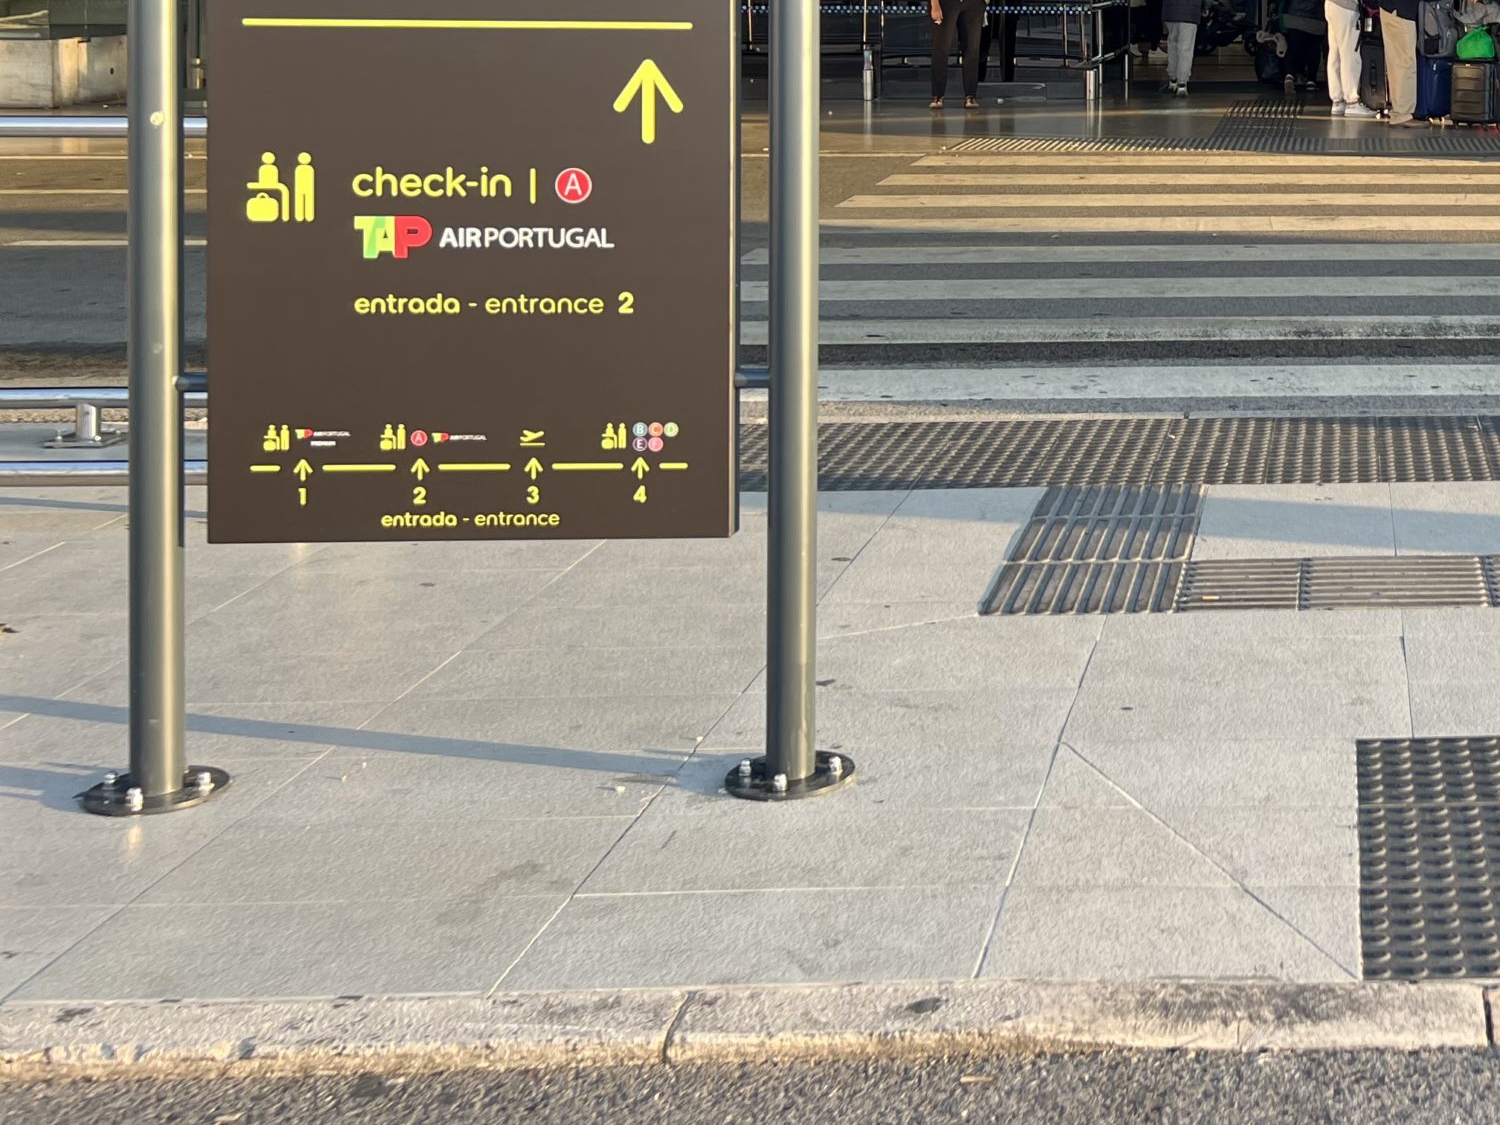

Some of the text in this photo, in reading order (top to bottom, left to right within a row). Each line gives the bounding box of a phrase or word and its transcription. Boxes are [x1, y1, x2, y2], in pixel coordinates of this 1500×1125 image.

[351, 167, 513, 198] check-in
[353, 215, 433, 260] TAP
[353, 293, 461, 316] entrada
[485, 293, 604, 316] entrance
[617, 292, 634, 314] 2
[298, 484, 647, 506] 1 2 3 4
[380, 511, 458, 527] entrada
[474, 511, 561, 527] entrance
